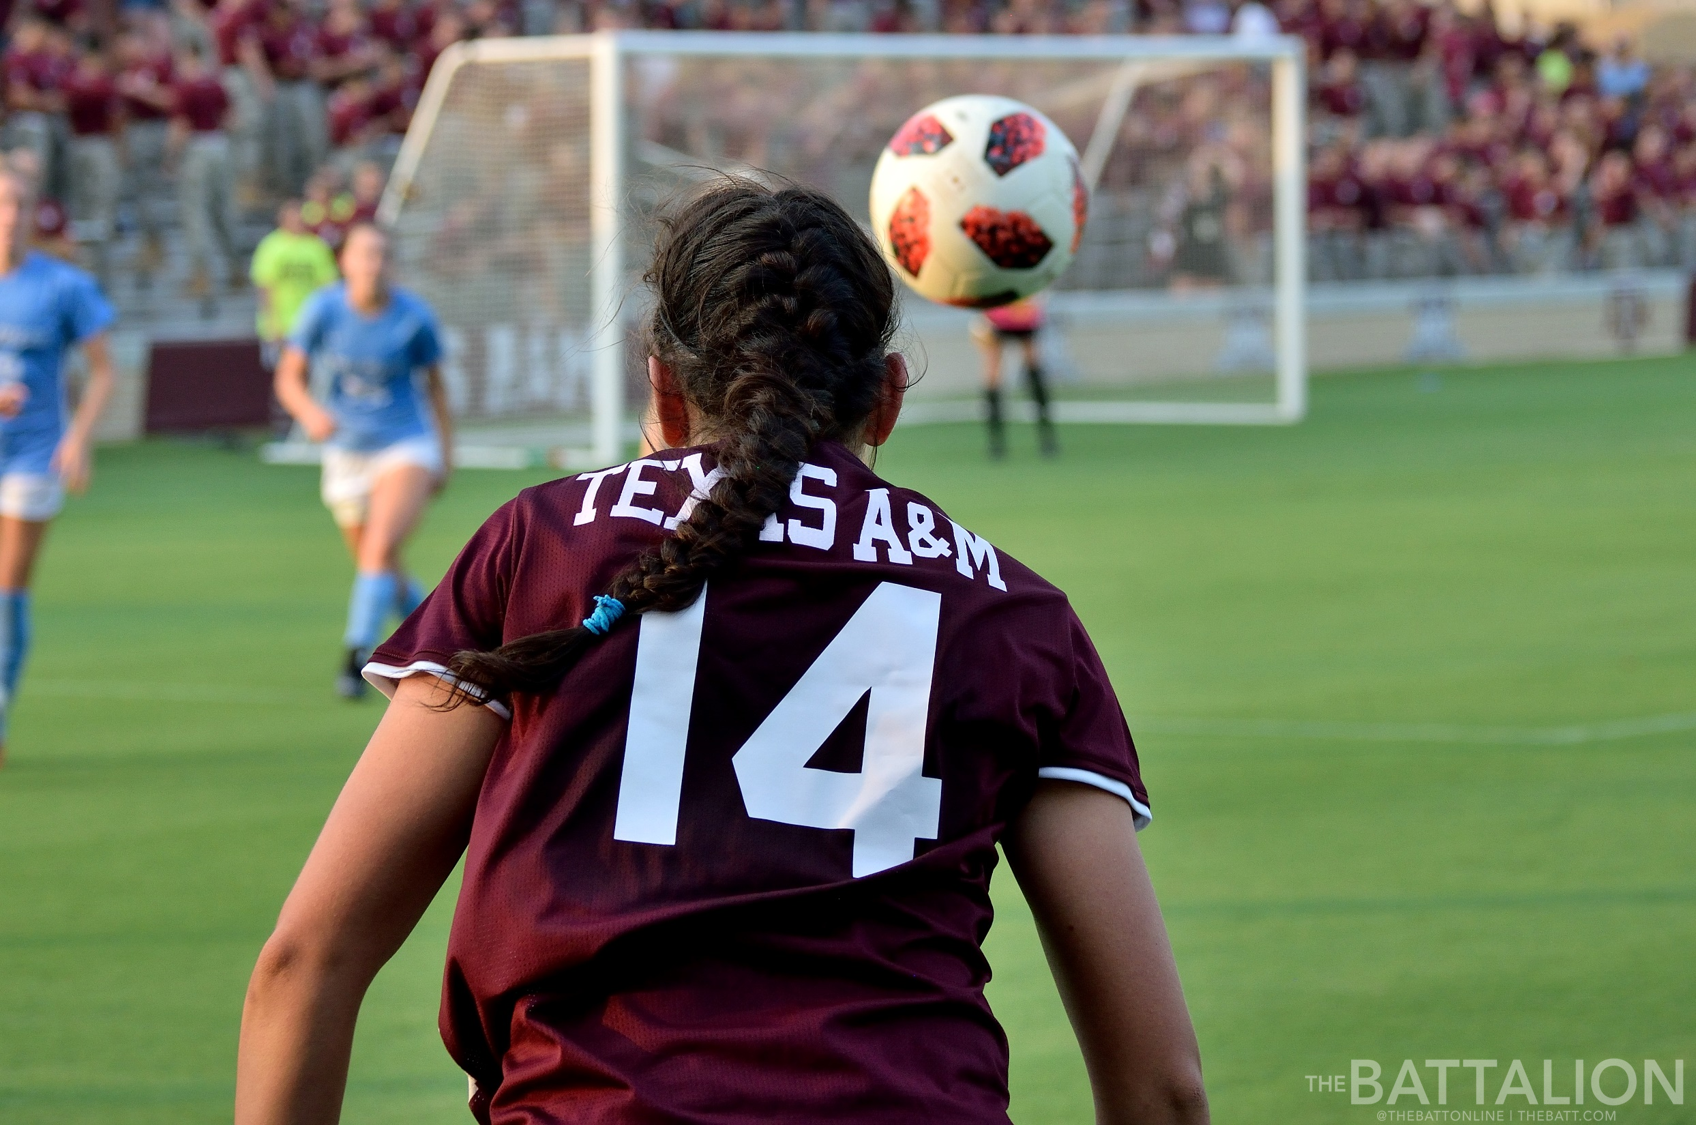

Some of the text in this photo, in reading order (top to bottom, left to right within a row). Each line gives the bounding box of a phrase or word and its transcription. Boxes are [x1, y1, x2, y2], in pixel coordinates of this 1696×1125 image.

[573, 453, 1007, 591] TEXS A&M
[614, 581, 942, 878] 14
